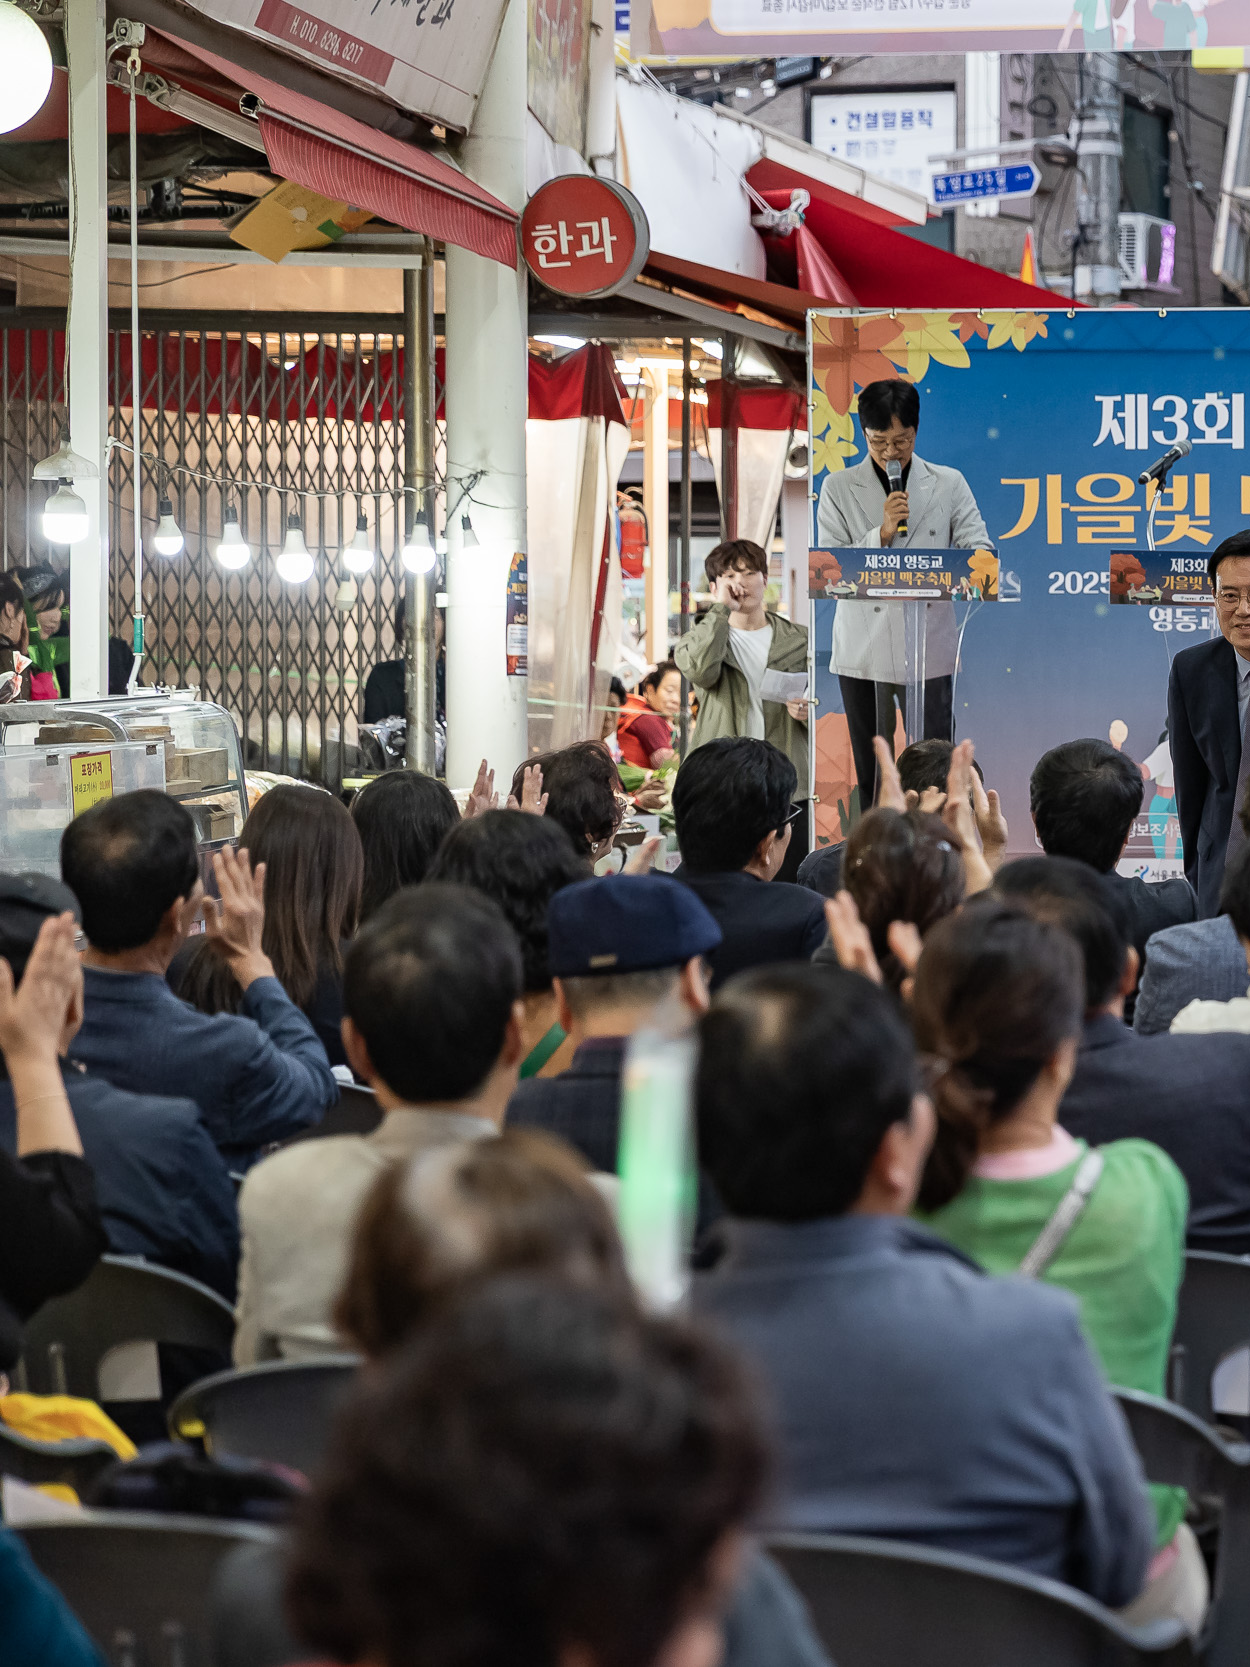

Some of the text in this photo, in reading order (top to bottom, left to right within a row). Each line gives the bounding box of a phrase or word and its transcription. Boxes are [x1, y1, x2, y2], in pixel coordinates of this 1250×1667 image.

[531, 216, 617, 268] 한과
[1093, 392, 1245, 450] 제3회
[998, 472, 1214, 547] 가을빛
[864, 554, 944, 570] 제3회 영동교
[1170, 557, 1208, 574] 제3회
[857, 571, 952, 587] 가을빛 맥주축제
[1161, 575, 1204, 591] 가을빛
[81, 761, 103, 776] 포장가격
